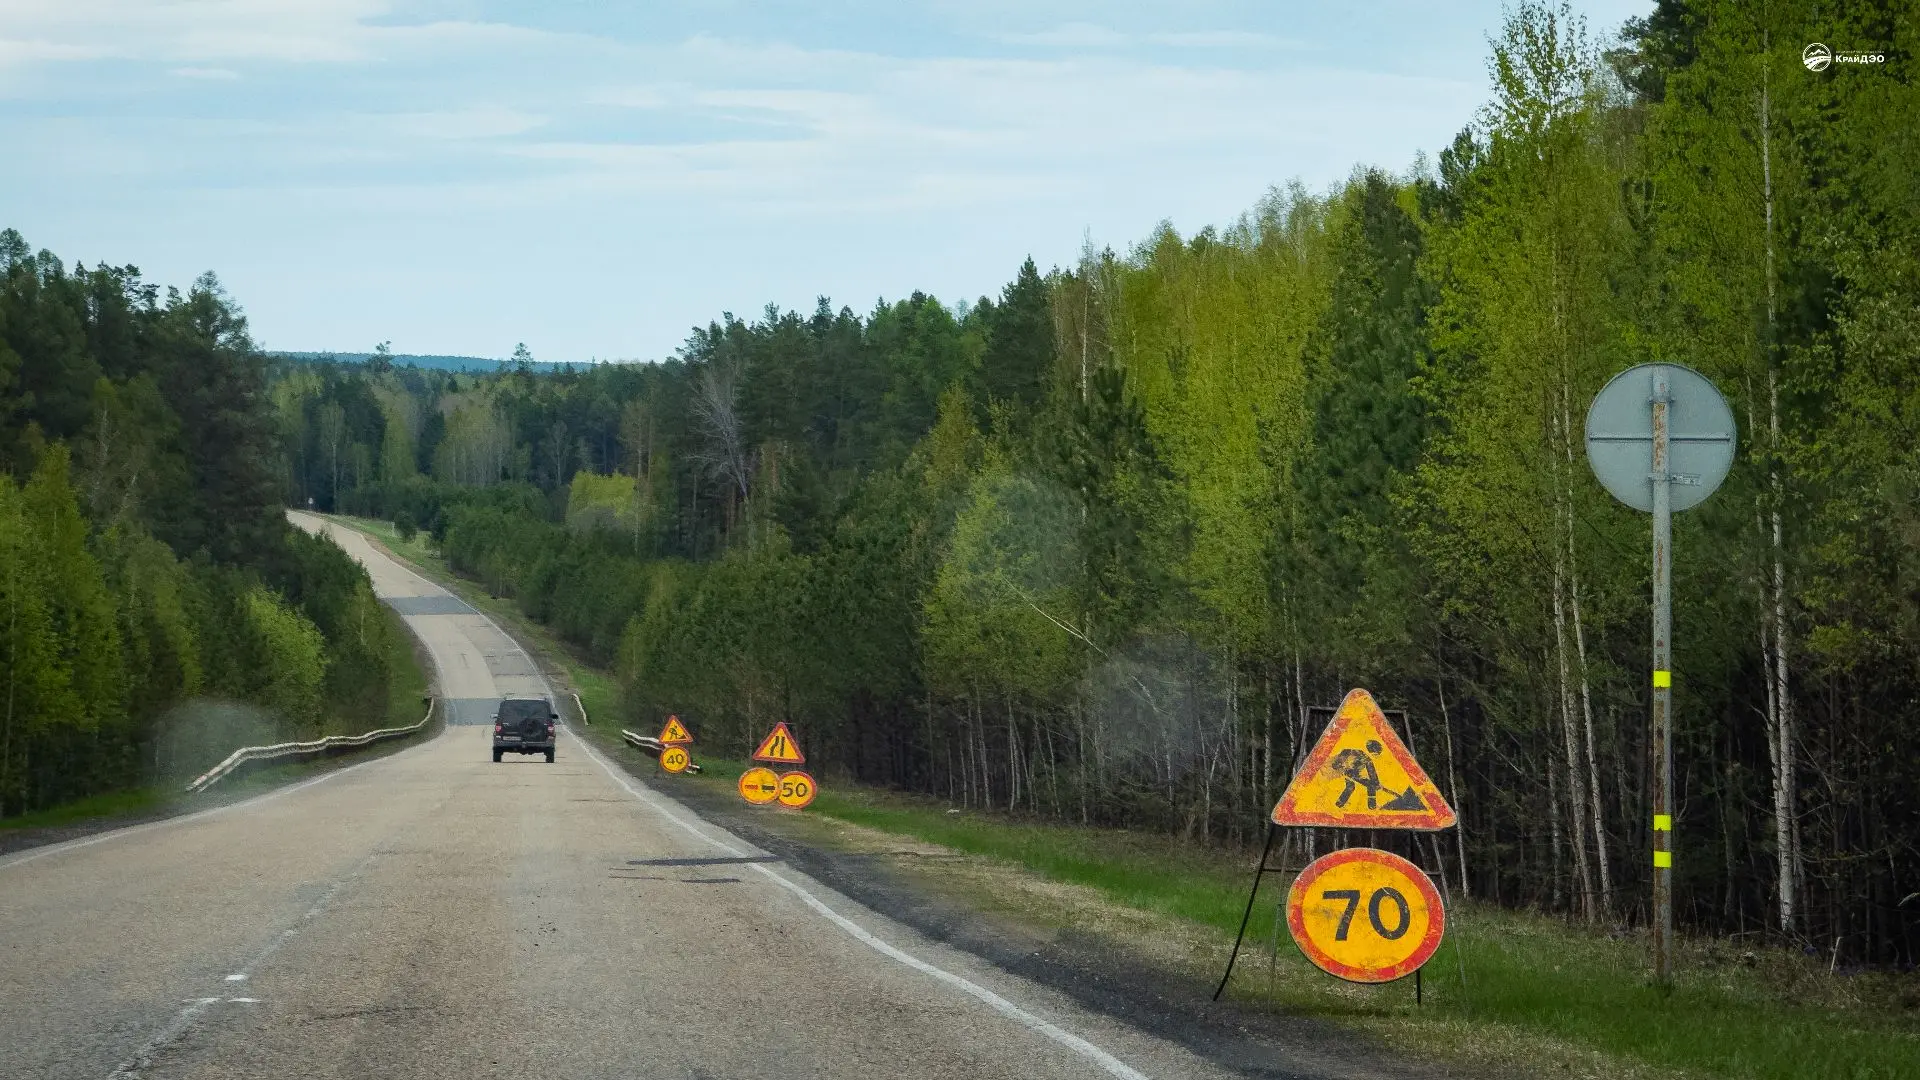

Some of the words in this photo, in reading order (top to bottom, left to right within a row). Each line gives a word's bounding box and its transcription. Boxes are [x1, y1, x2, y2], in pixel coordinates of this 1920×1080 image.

[666, 754, 684, 765] 40
[782, 782, 808, 798] 50
[1322, 886, 1411, 941] 70
